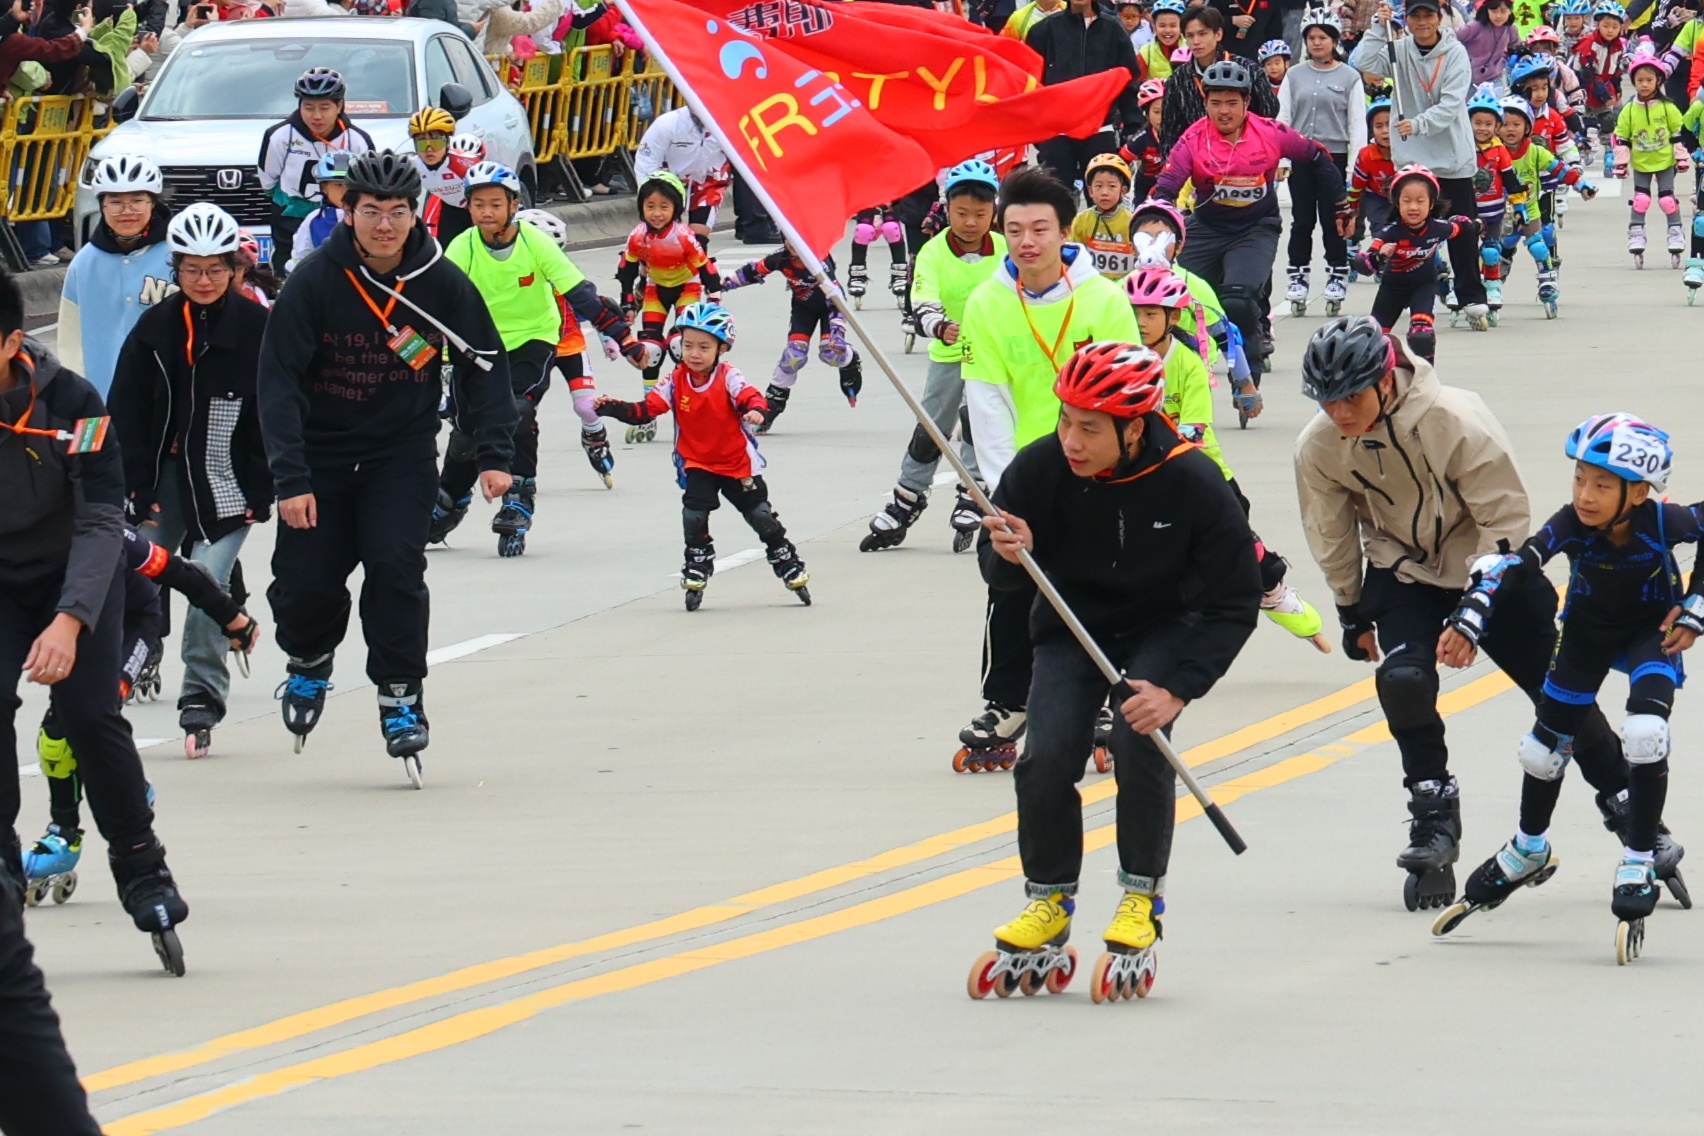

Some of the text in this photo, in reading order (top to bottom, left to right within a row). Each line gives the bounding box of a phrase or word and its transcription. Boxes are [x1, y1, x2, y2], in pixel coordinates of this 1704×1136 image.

[1091, 251, 1137, 271] 961
[361, 351, 388, 364] the
[389, 369, 409, 382] on
[414, 369, 429, 382] th
[1616, 444, 1659, 473] 230
